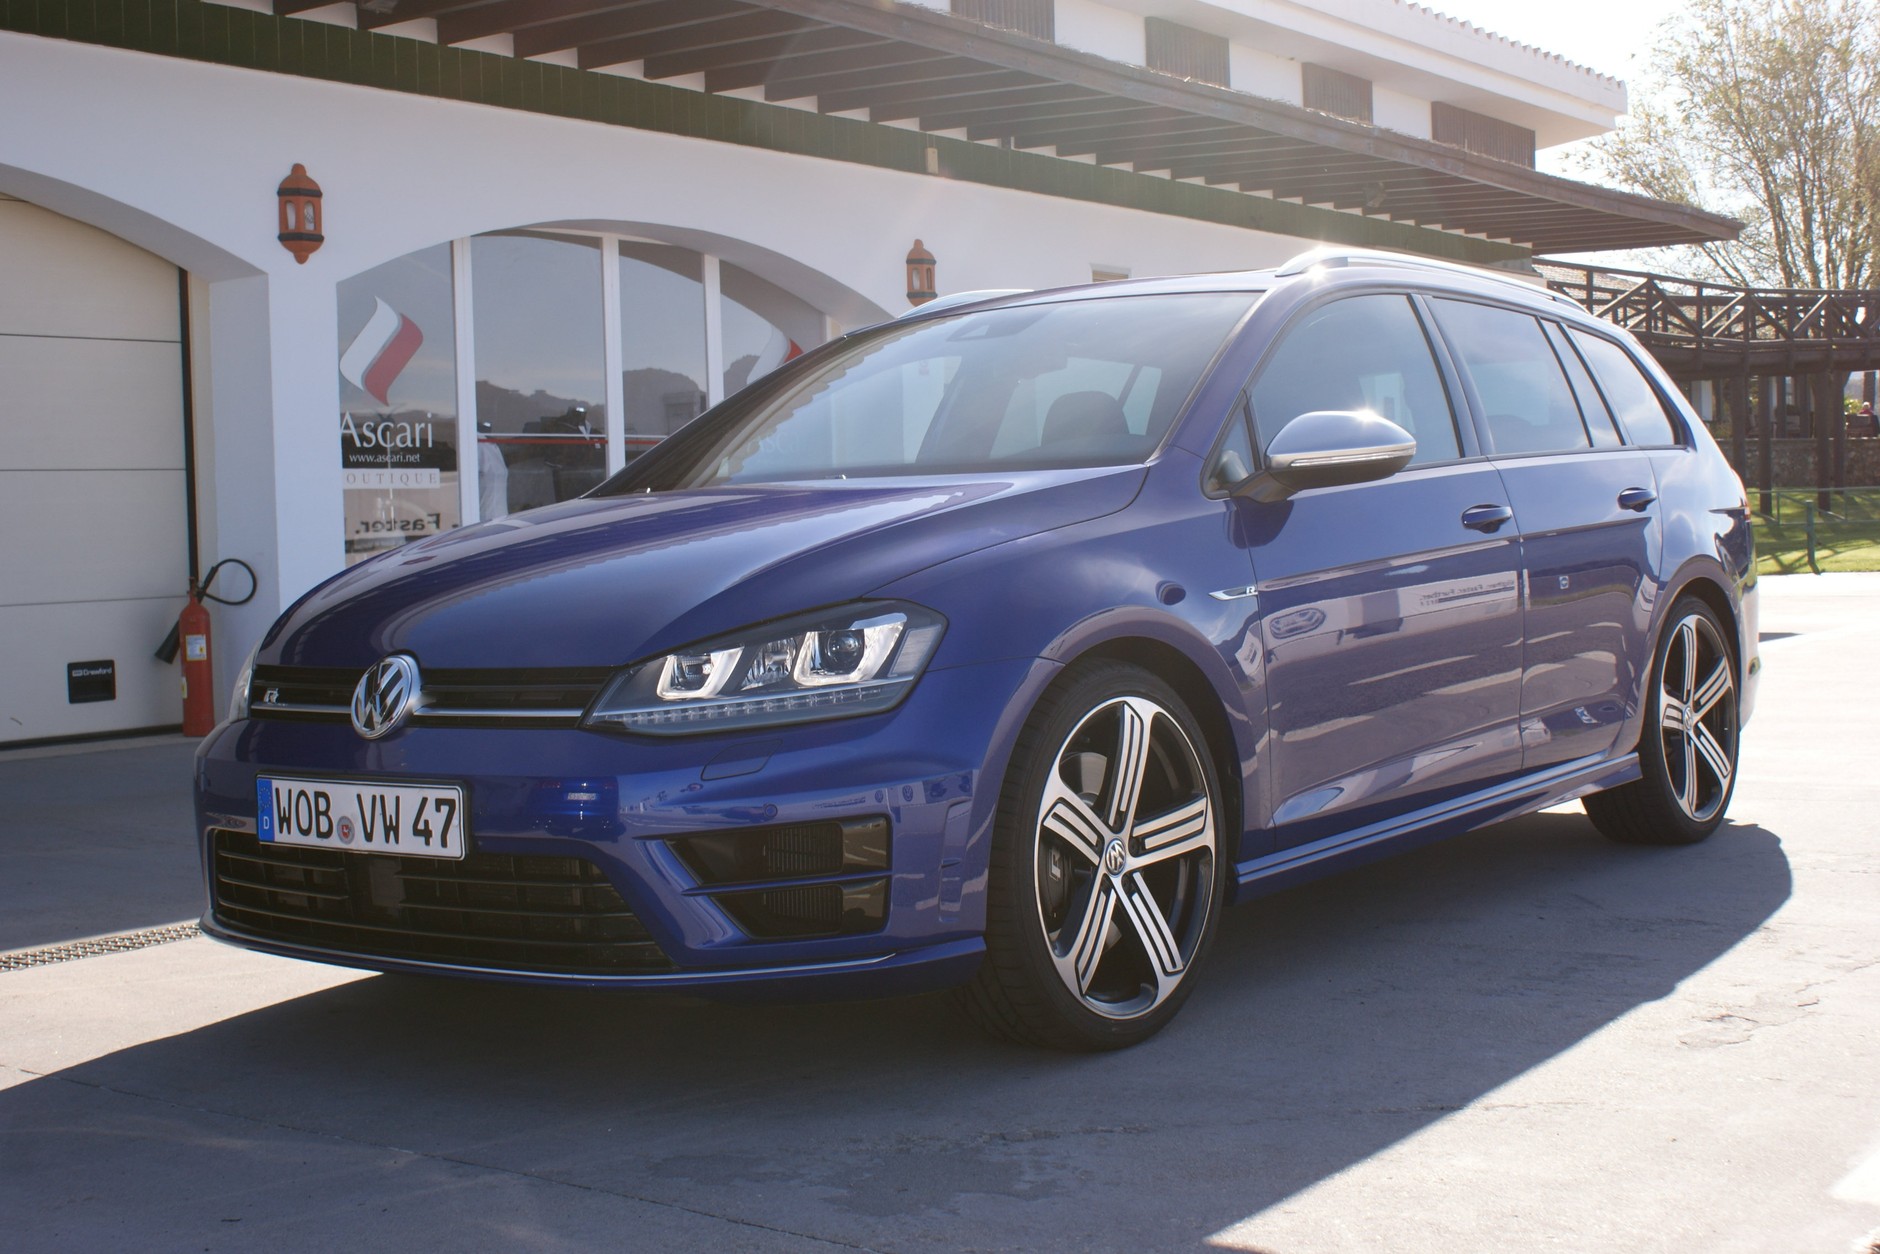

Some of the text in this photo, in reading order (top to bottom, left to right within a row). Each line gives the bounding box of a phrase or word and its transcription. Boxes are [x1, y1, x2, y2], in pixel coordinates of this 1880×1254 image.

[341, 411, 433, 448] Ascari
[349, 453, 420, 463] www.ascari.net
[263, 816, 270, 829] D
[275, 787, 457, 848] WOB VW 47
